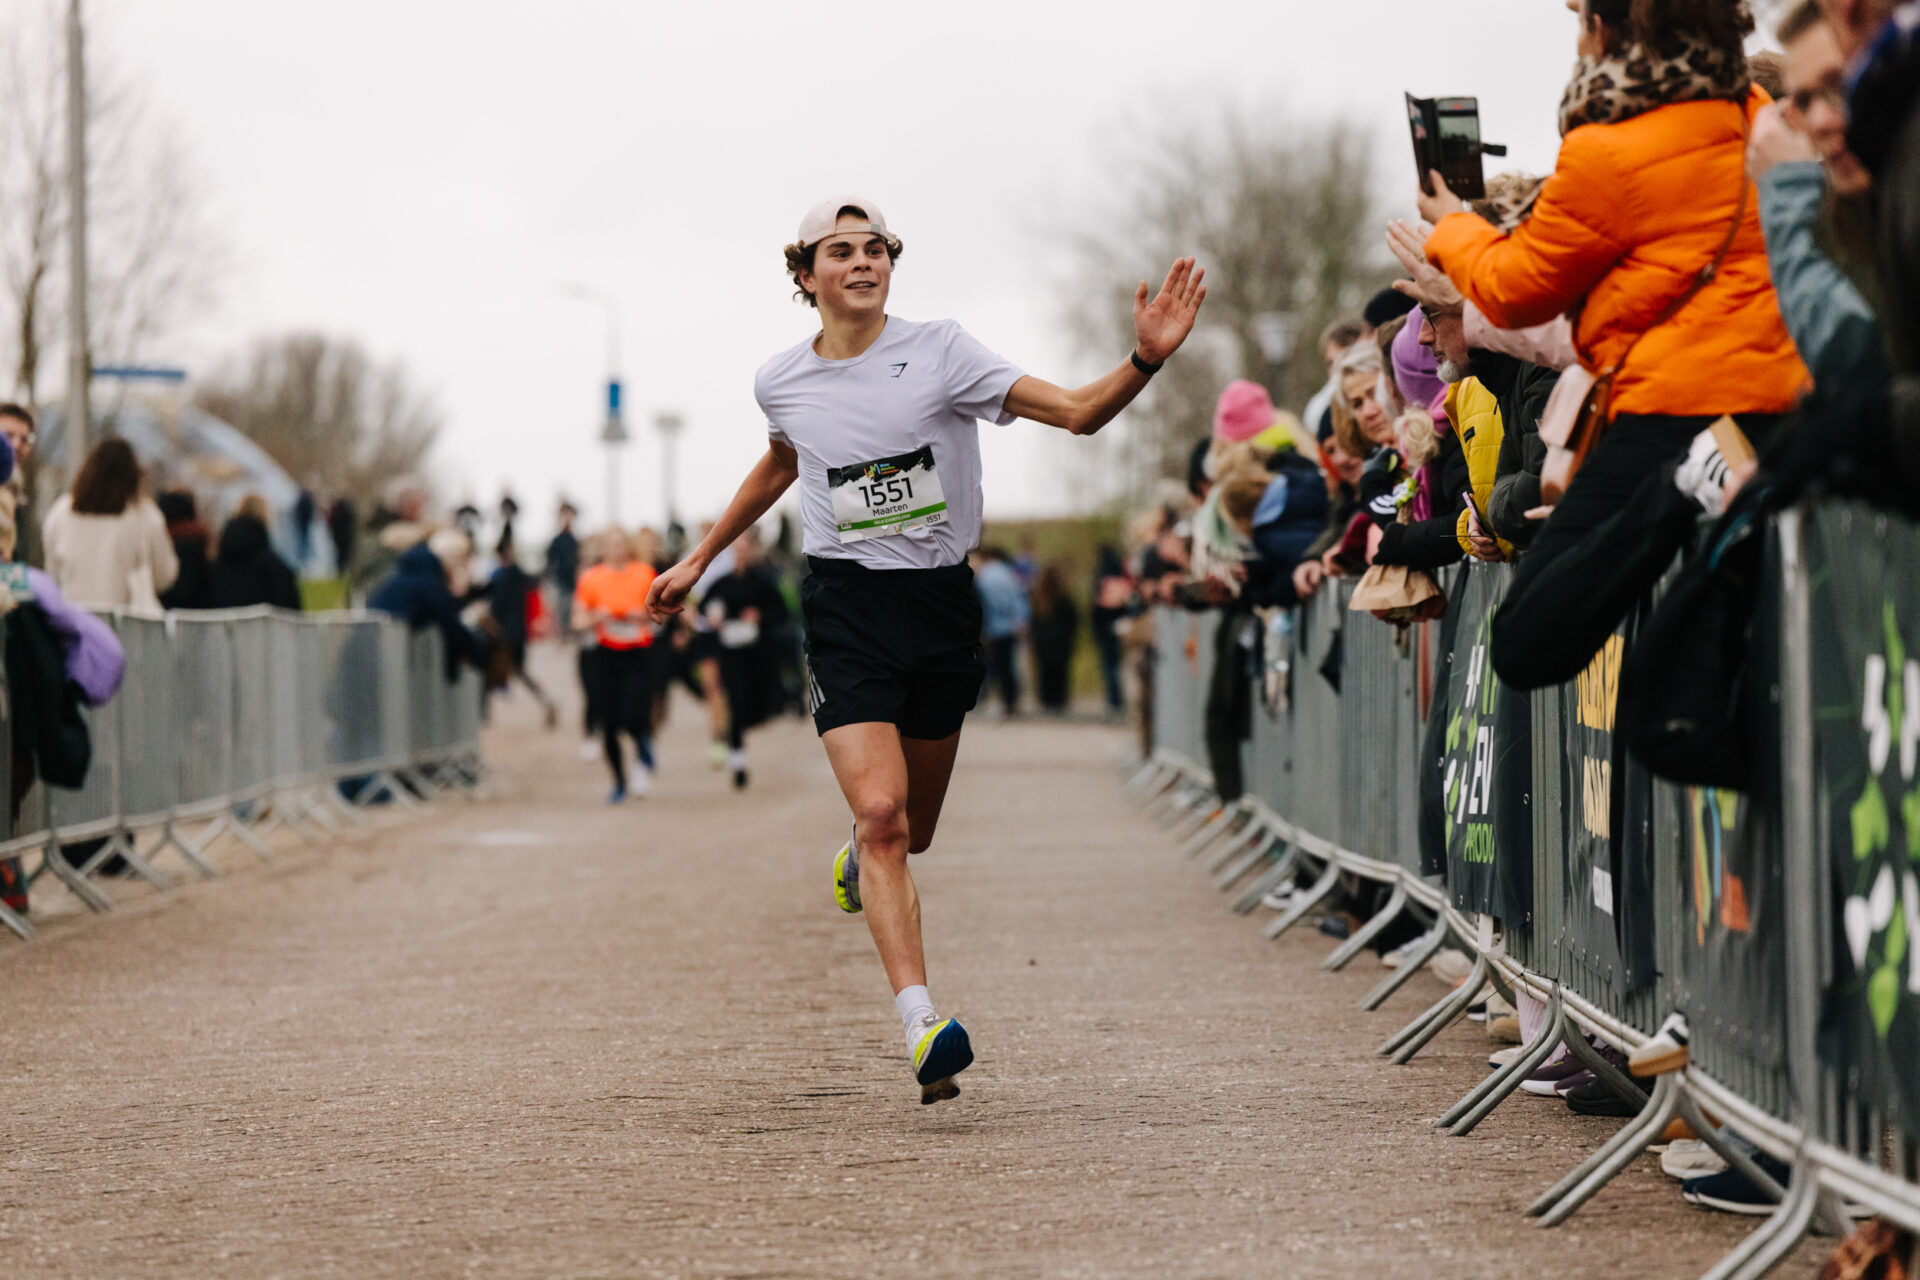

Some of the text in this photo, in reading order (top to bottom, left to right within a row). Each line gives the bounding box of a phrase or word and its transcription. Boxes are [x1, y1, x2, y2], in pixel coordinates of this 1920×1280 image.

[858, 477, 913, 508] 1551
[872, 503, 908, 517] Maarten
[926, 513, 941, 524] 1551
